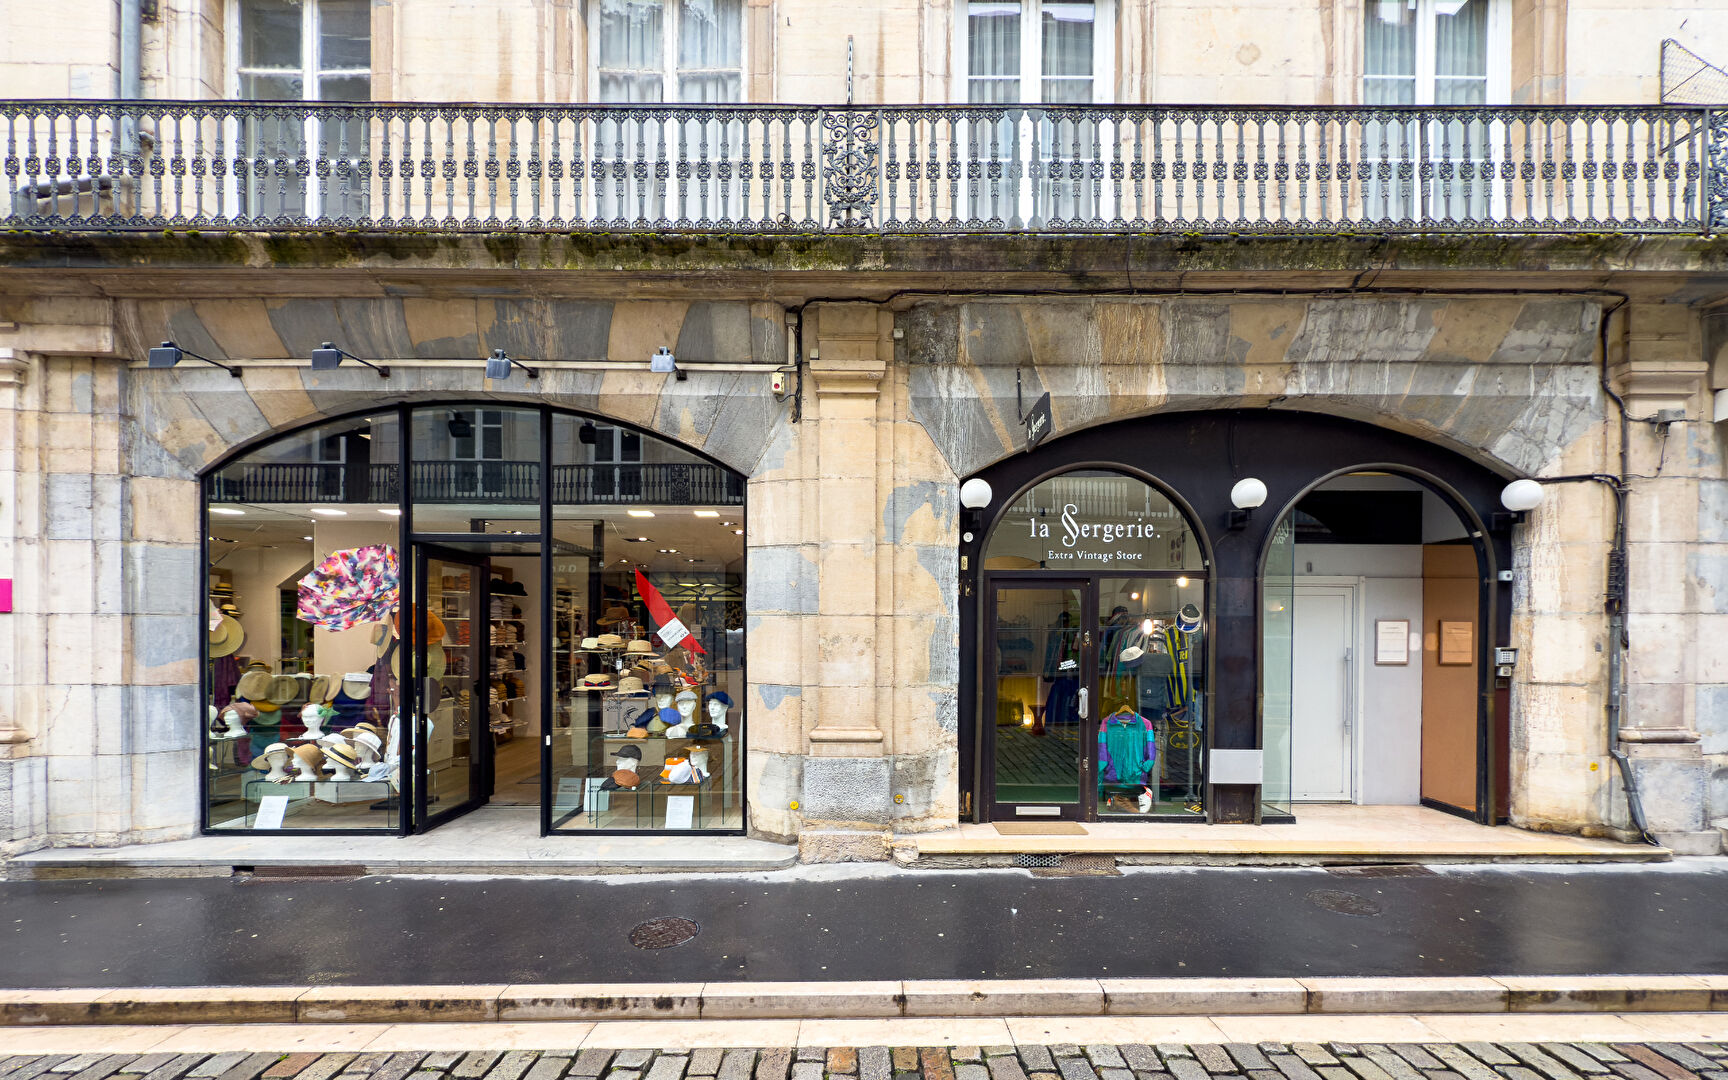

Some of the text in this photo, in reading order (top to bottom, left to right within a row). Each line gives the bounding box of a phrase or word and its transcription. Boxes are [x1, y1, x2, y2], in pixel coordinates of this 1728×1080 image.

[1030, 518, 1049, 537] la
[1048, 550, 1142, 563] Extra Vintage Store
